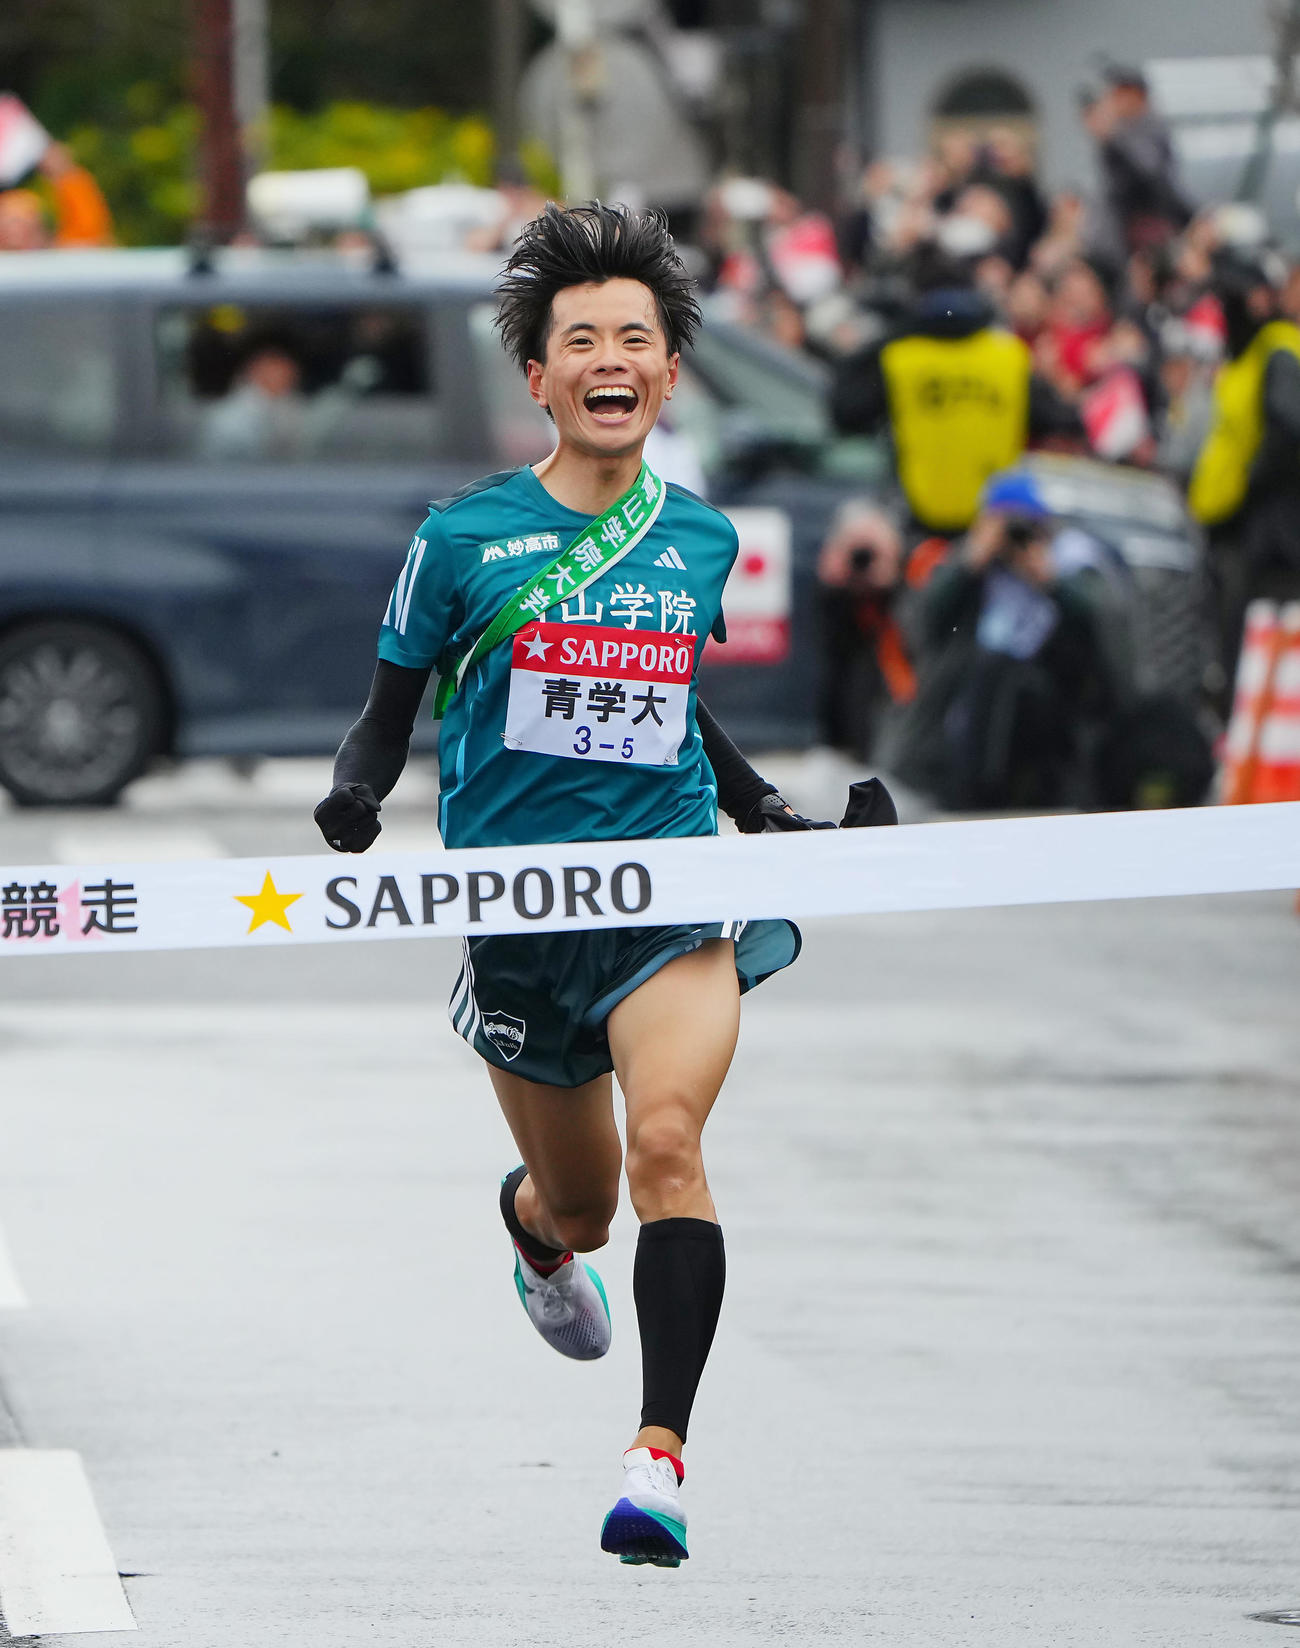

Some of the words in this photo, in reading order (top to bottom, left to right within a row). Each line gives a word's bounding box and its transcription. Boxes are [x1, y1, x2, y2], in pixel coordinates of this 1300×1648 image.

[507, 534, 559, 557] 妙高市
[537, 582, 697, 636] 山学院
[560, 638, 690, 674] SAPPORO
[542, 678, 667, 728] 青学大
[2, 878, 138, 938] 競走
[325, 862, 652, 929] SAPPORO
